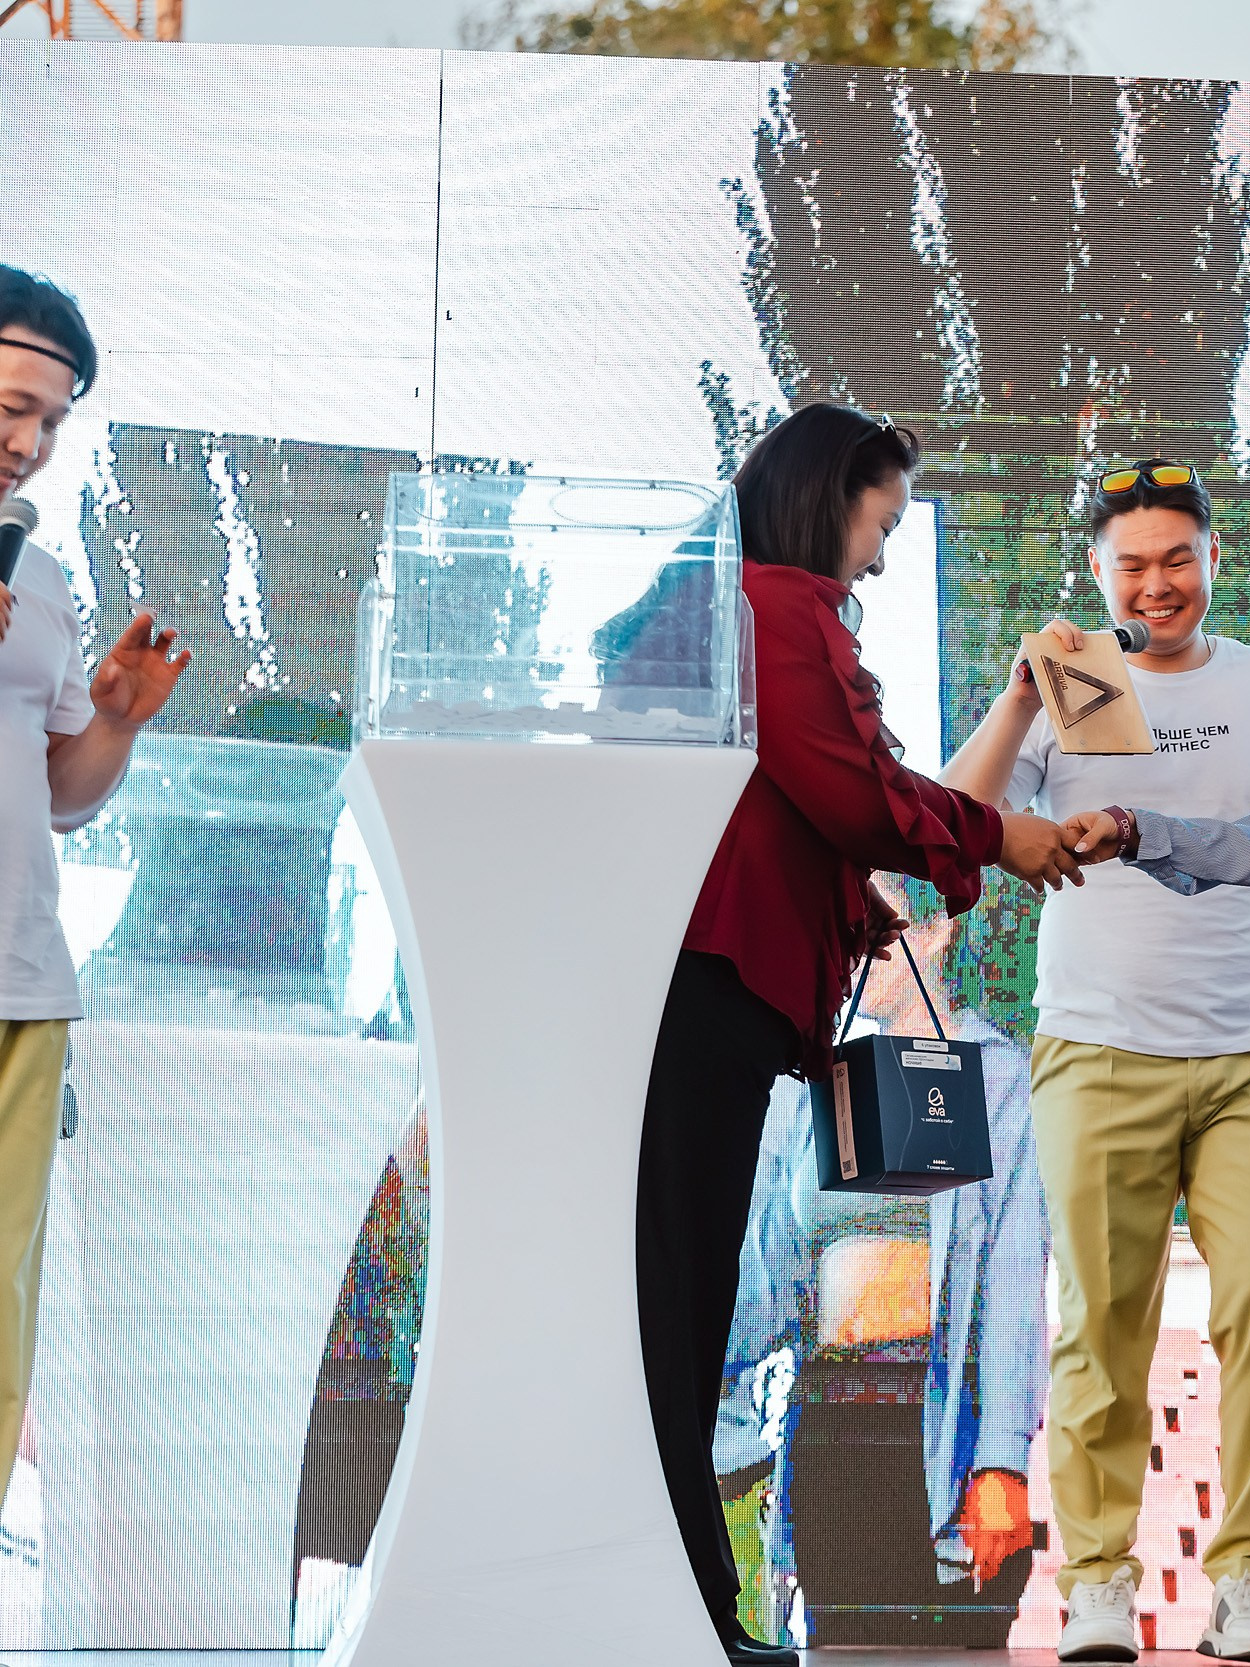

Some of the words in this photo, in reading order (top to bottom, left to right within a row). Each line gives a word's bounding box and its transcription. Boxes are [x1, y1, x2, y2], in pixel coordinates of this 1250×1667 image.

[1053, 661, 1068, 691] ARRIVA
[1152, 728, 1193, 740] ЛЬШЕ
[1196, 725, 1230, 737] ЧЕМ
[1154, 739, 1211, 753] ИТНЕС
[928, 1106, 946, 1117] eva
